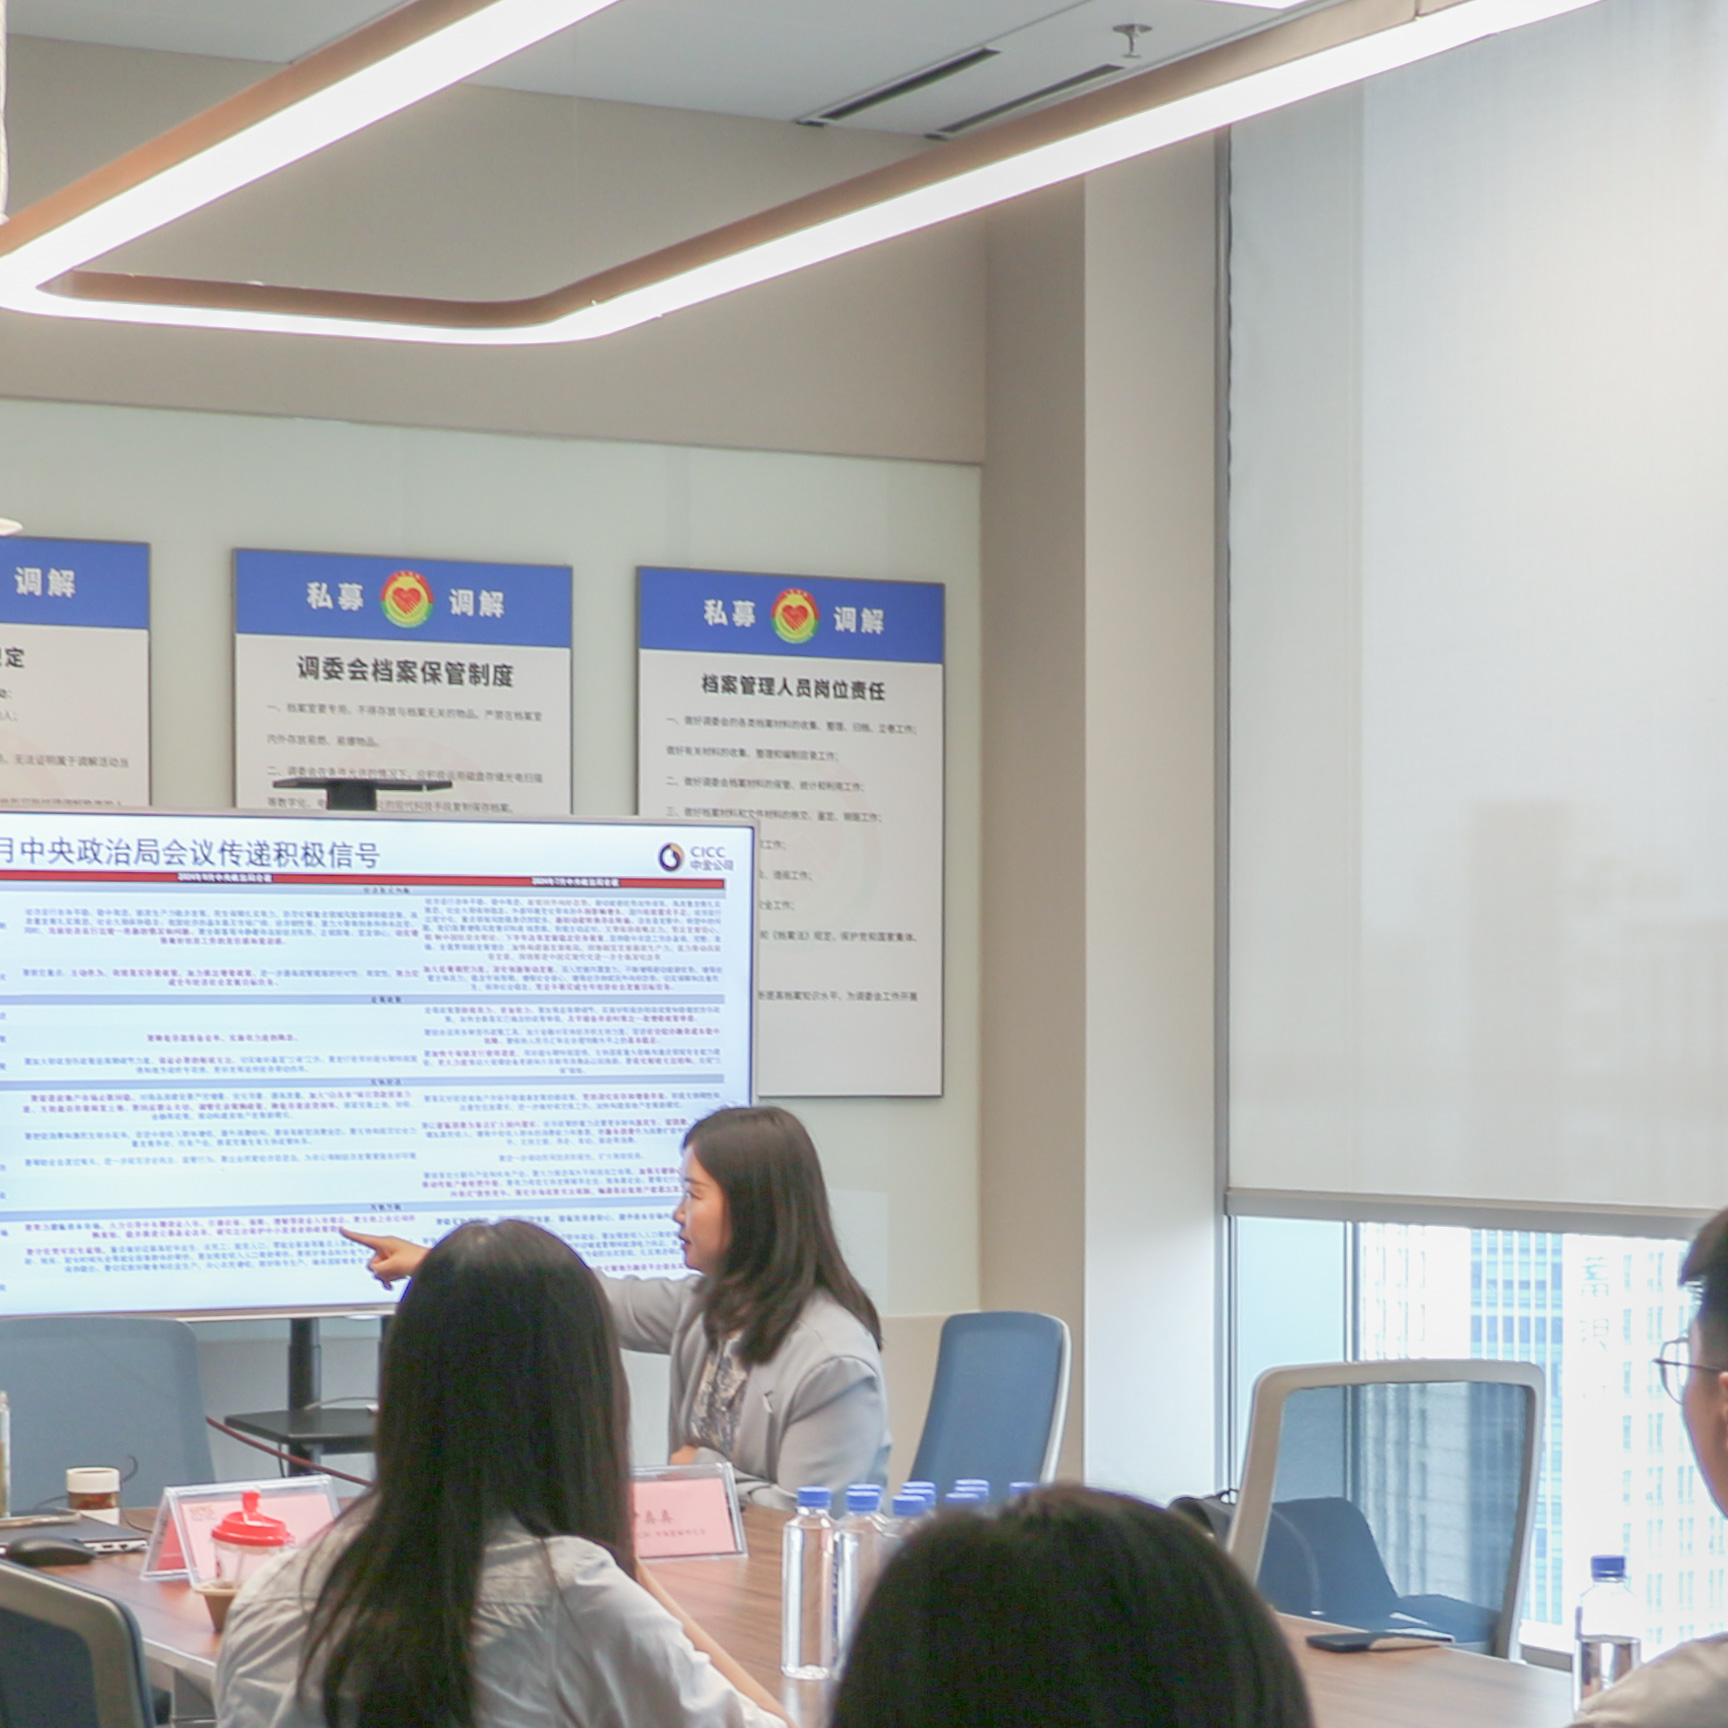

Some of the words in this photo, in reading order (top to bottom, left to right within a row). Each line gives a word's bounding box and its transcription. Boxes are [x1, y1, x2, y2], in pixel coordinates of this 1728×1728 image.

[14, 567, 75, 598] 调解
[307, 582, 363, 611] 私募
[449, 589, 504, 618] 调解
[704, 599, 755, 627] 私募
[834, 606, 884, 634] 调解
[297, 656, 513, 687] 调委会档案保管制度
[702, 674, 885, 700] 档案管理人员岗位责任
[690, 846, 725, 858] CICC
[690, 859, 734, 871] 中金公司
